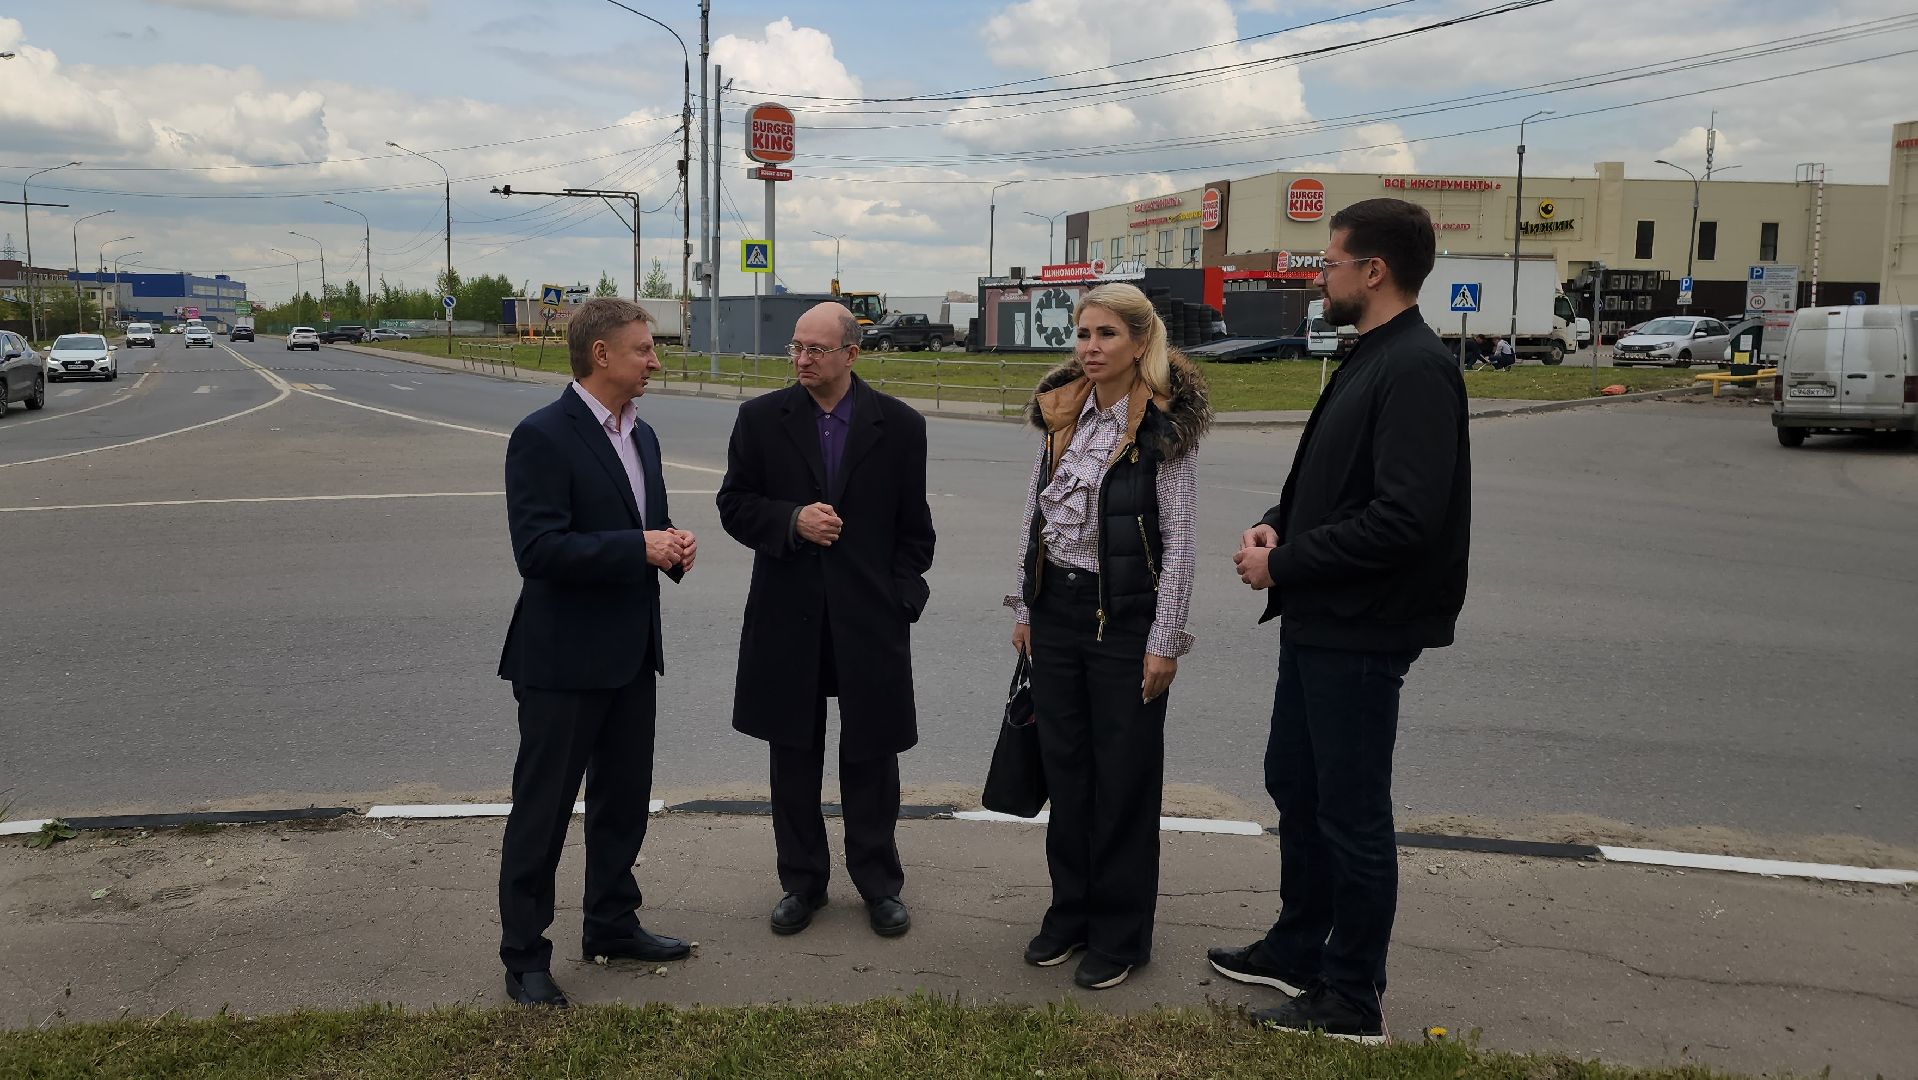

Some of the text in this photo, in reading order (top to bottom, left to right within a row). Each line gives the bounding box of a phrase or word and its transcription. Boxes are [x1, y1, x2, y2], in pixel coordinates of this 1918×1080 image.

[753, 121, 793, 136] BURGER
[753, 132, 793, 151] KING
[1410, 179, 1493, 190] ИНСТРУМЕНТЫ
[1290, 191, 1324, 199] BURGER
[1290, 200, 1324, 211] KING
[1203, 209, 1218, 221] KING
[1753, 268, 1762, 279] P
[1682, 278, 1690, 290] P
